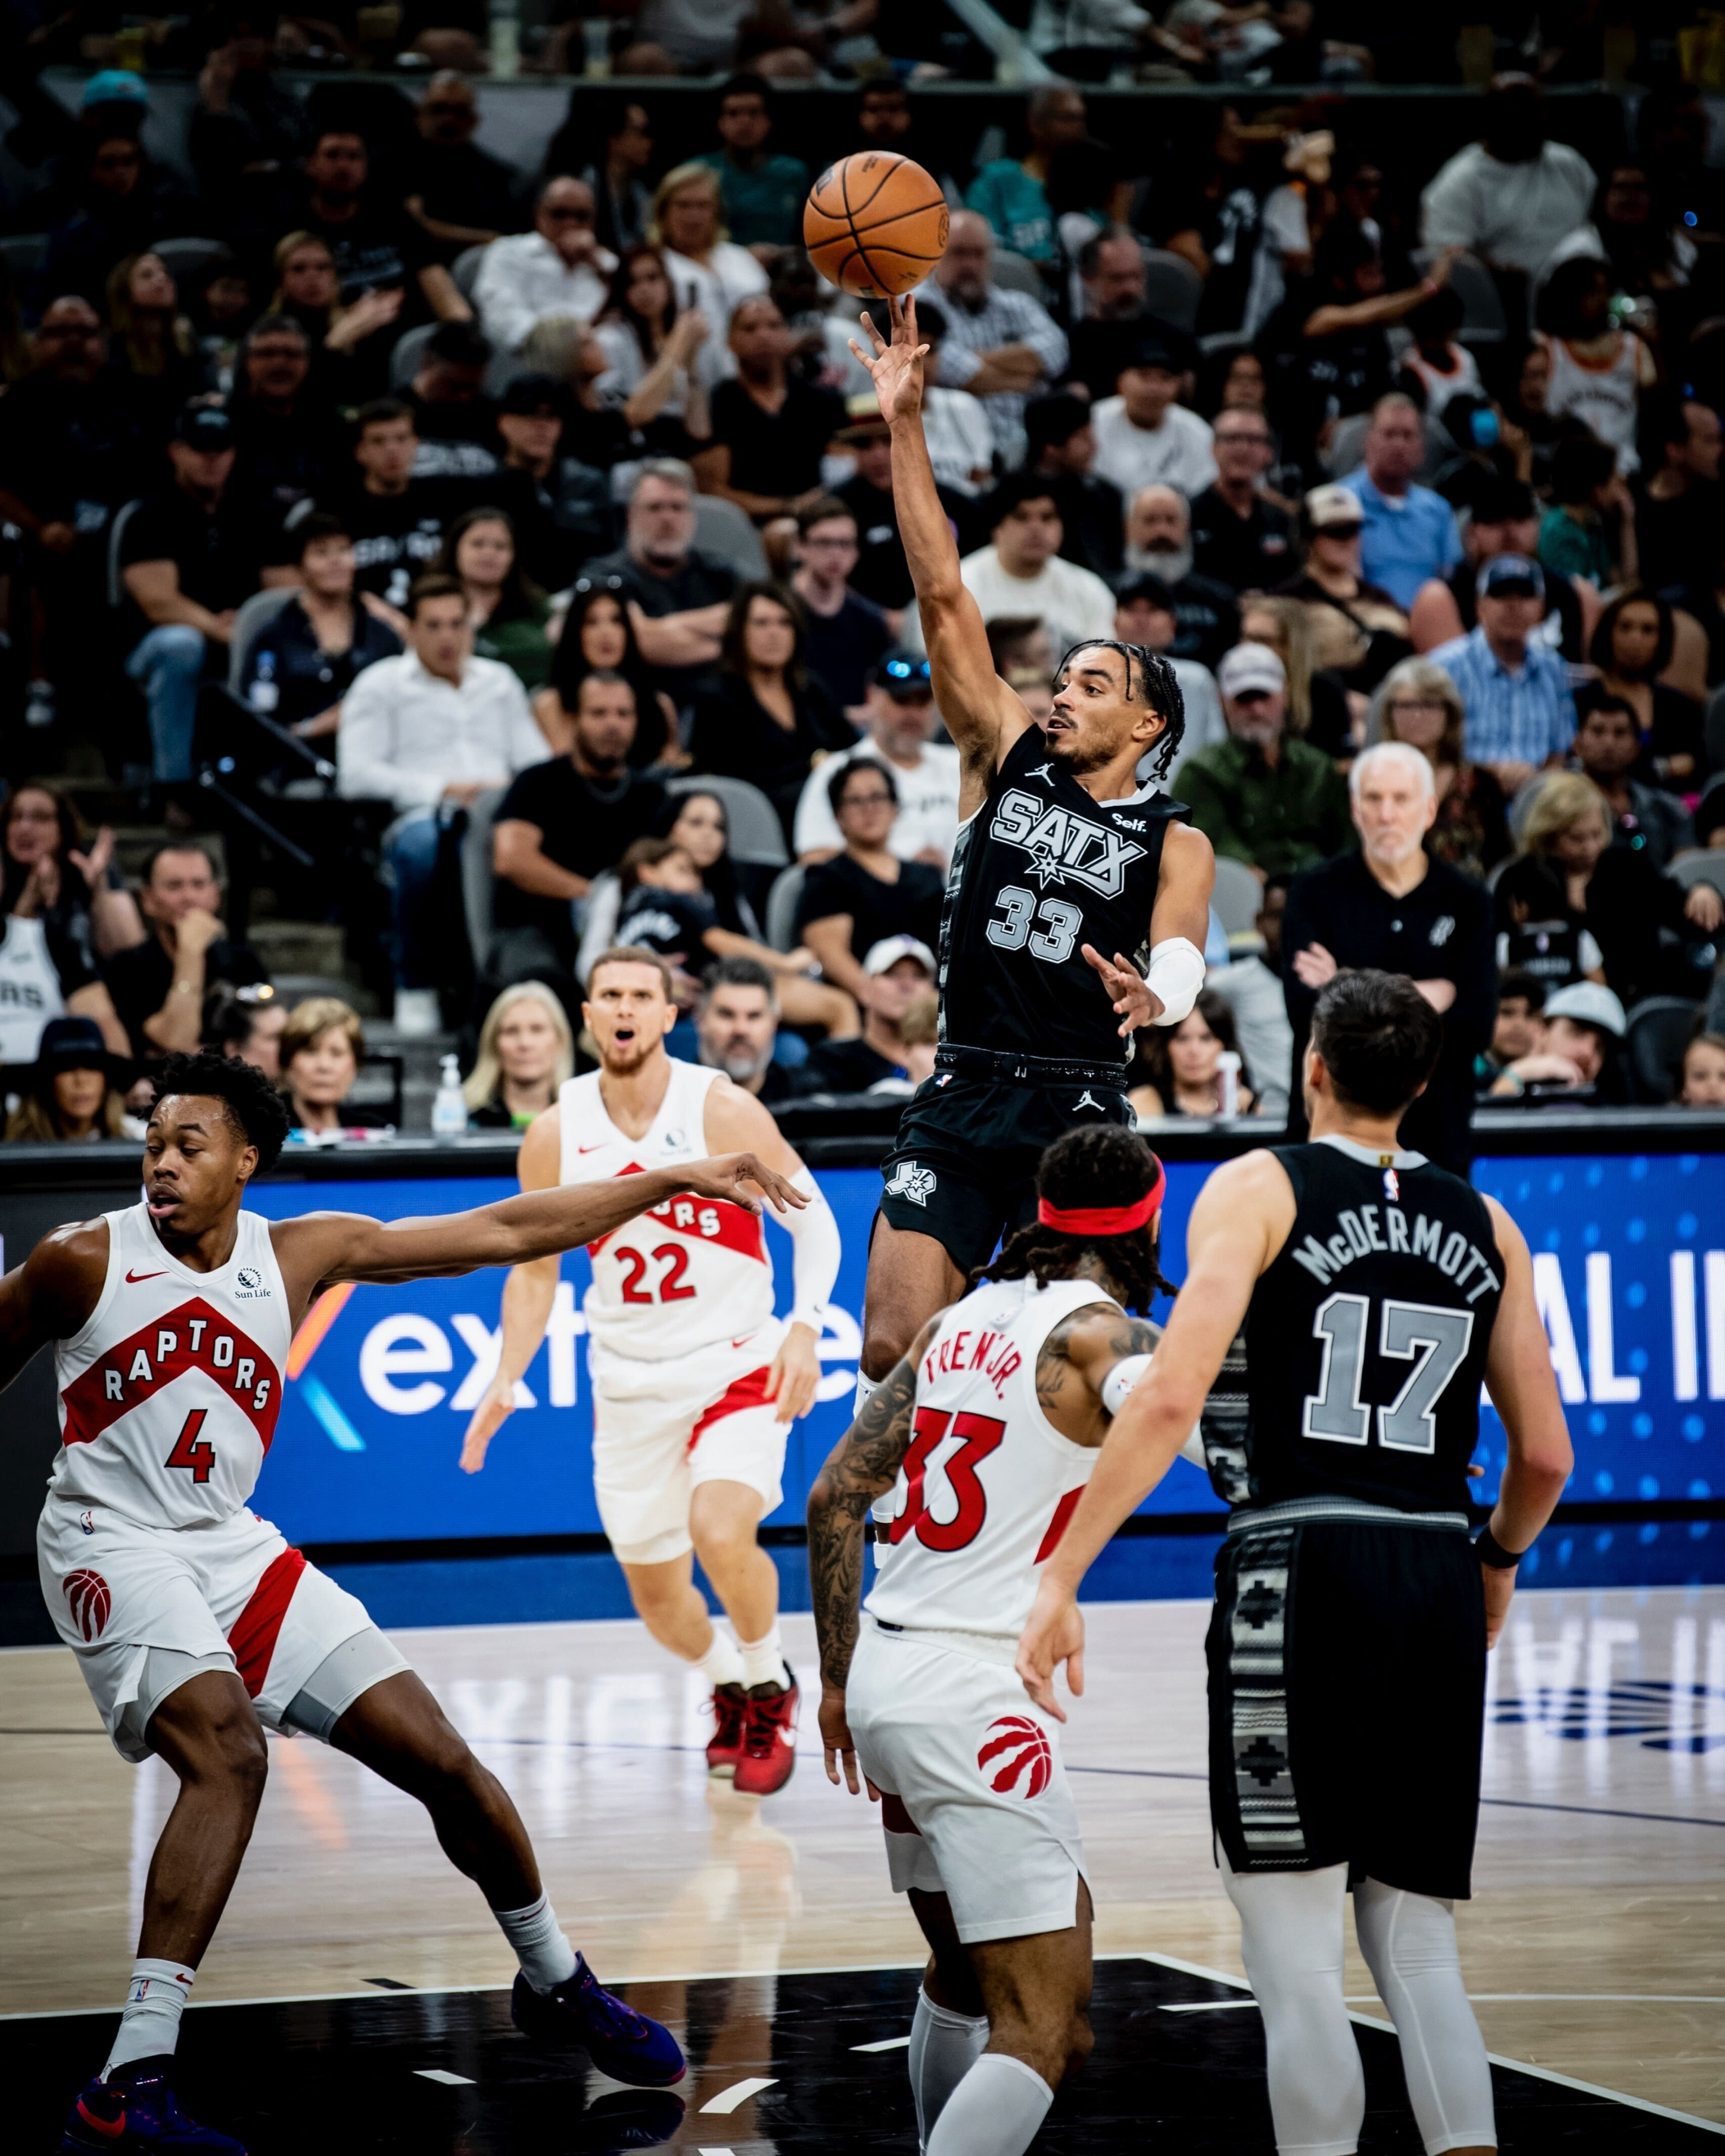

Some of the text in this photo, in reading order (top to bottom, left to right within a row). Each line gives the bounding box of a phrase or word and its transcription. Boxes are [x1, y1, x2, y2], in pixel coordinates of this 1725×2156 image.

[990, 787, 1148, 901] SATX
[1111, 812, 1147, 833] Self.
[986, 884, 1084, 964] 33
[235, 1288, 272, 1299] Sun Life
[614, 1242, 697, 1304] 22
[1291, 1203, 1500, 1304] McDERMOTT
[104, 1319, 271, 1410] RAPTORS
[925, 1331, 1005, 1385] TREN
[1302, 1292, 1475, 1454] 17
[164, 1409, 216, 1484] 4
[889, 1406, 1007, 1552] 33
